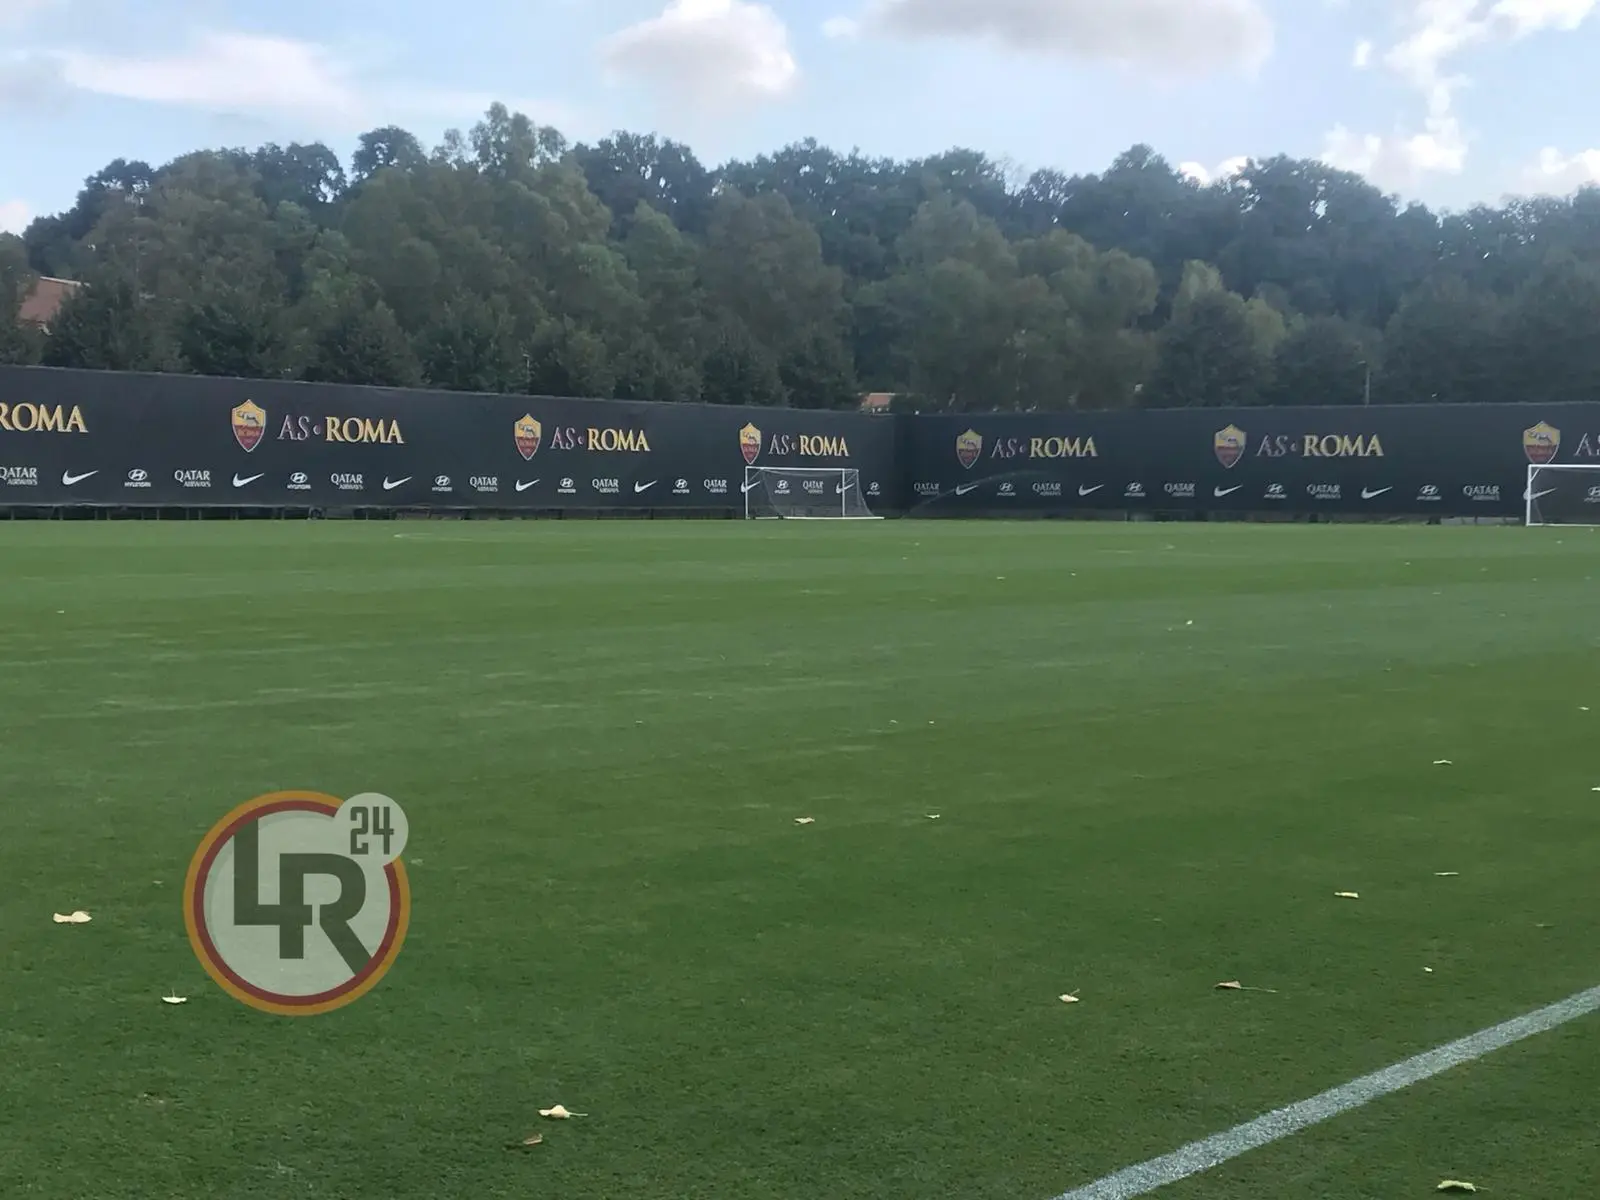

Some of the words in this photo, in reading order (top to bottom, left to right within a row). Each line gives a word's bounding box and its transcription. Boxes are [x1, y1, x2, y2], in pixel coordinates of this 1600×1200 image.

[0, 402, 89, 433] ROMA
[277, 414, 309, 441] AS
[325, 416, 404, 444] ROMA
[550, 427, 576, 450] AS
[587, 428, 651, 452] ROMA
[768, 434, 790, 456] AS
[799, 435, 849, 457] ROMA
[1256, 435, 1288, 457] AS
[1303, 434, 1384, 457] ROMA
[990, 438, 1017, 458] AS
[1029, 436, 1098, 458] ROMA
[0, 466, 37, 480] QATAR
[174, 470, 210, 482] QATAR
[330, 473, 363, 485] QATAR
[469, 476, 498, 489] QATAR
[592, 478, 619, 490] QATAR
[703, 479, 728, 490] QATAR
[802, 480, 824, 491] QATAR
[1032, 482, 1061, 493] QATAR
[1463, 485, 1500, 496] QATAR
